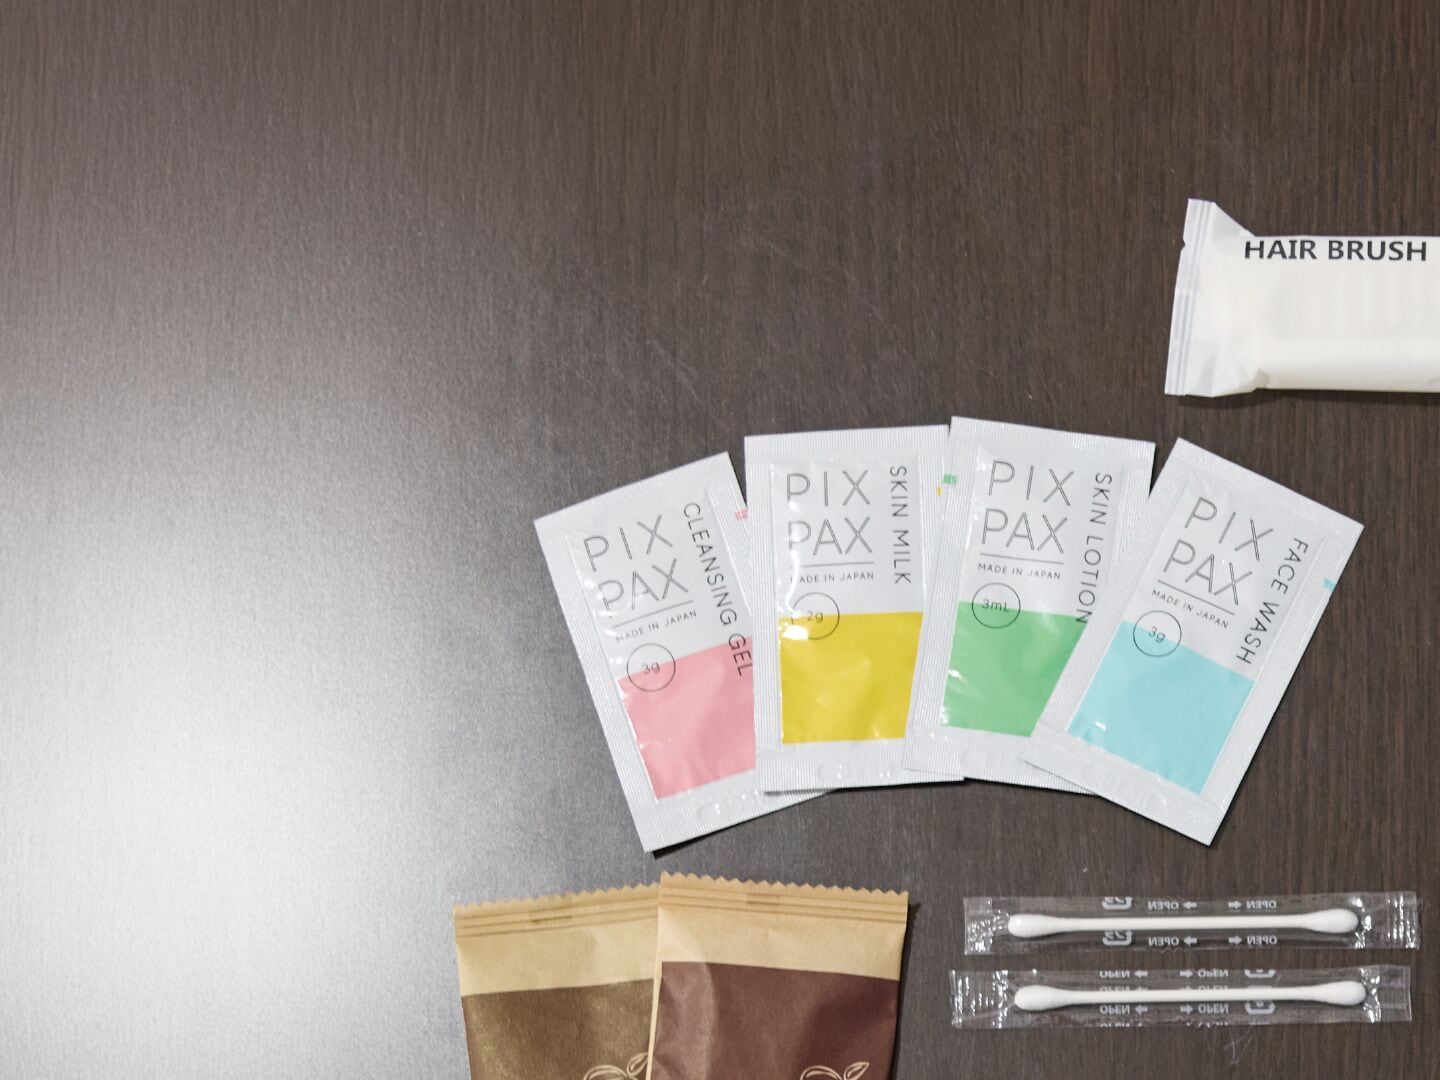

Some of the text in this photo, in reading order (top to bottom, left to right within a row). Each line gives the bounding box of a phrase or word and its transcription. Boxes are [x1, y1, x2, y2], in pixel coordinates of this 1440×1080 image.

[1244, 239, 1427, 262] HAIR BRUSH
[786, 469, 871, 507] PIX
[988, 459, 1075, 507] PIX
[584, 515, 673, 572] PIX
[788, 517, 873, 556] PAX
[890, 465, 912, 584] SKIN MILK
[981, 507, 1068, 554] PAX
[1183, 496, 1275, 561] PIX
[1075, 472, 1113, 624] SKIN LOTION
[598, 558, 689, 616] PAX
[683, 502, 753, 677] CLEANSING GEL
[824, 572, 835, 582] IN
[840, 571, 874, 582] JAPAN
[978, 562, 1061, 580] MADE IN JAPAN
[1162, 539, 1253, 606] PAX
[806, 609, 824, 623] 2g
[1151, 589, 1229, 629] MADE IN JAPAN
[1235, 537, 1309, 665] FACE WASH
[615, 609, 697, 642] MADE IN JAPAN
[1148, 626, 1166, 643] 3g
[641, 661, 661, 674] 3g
